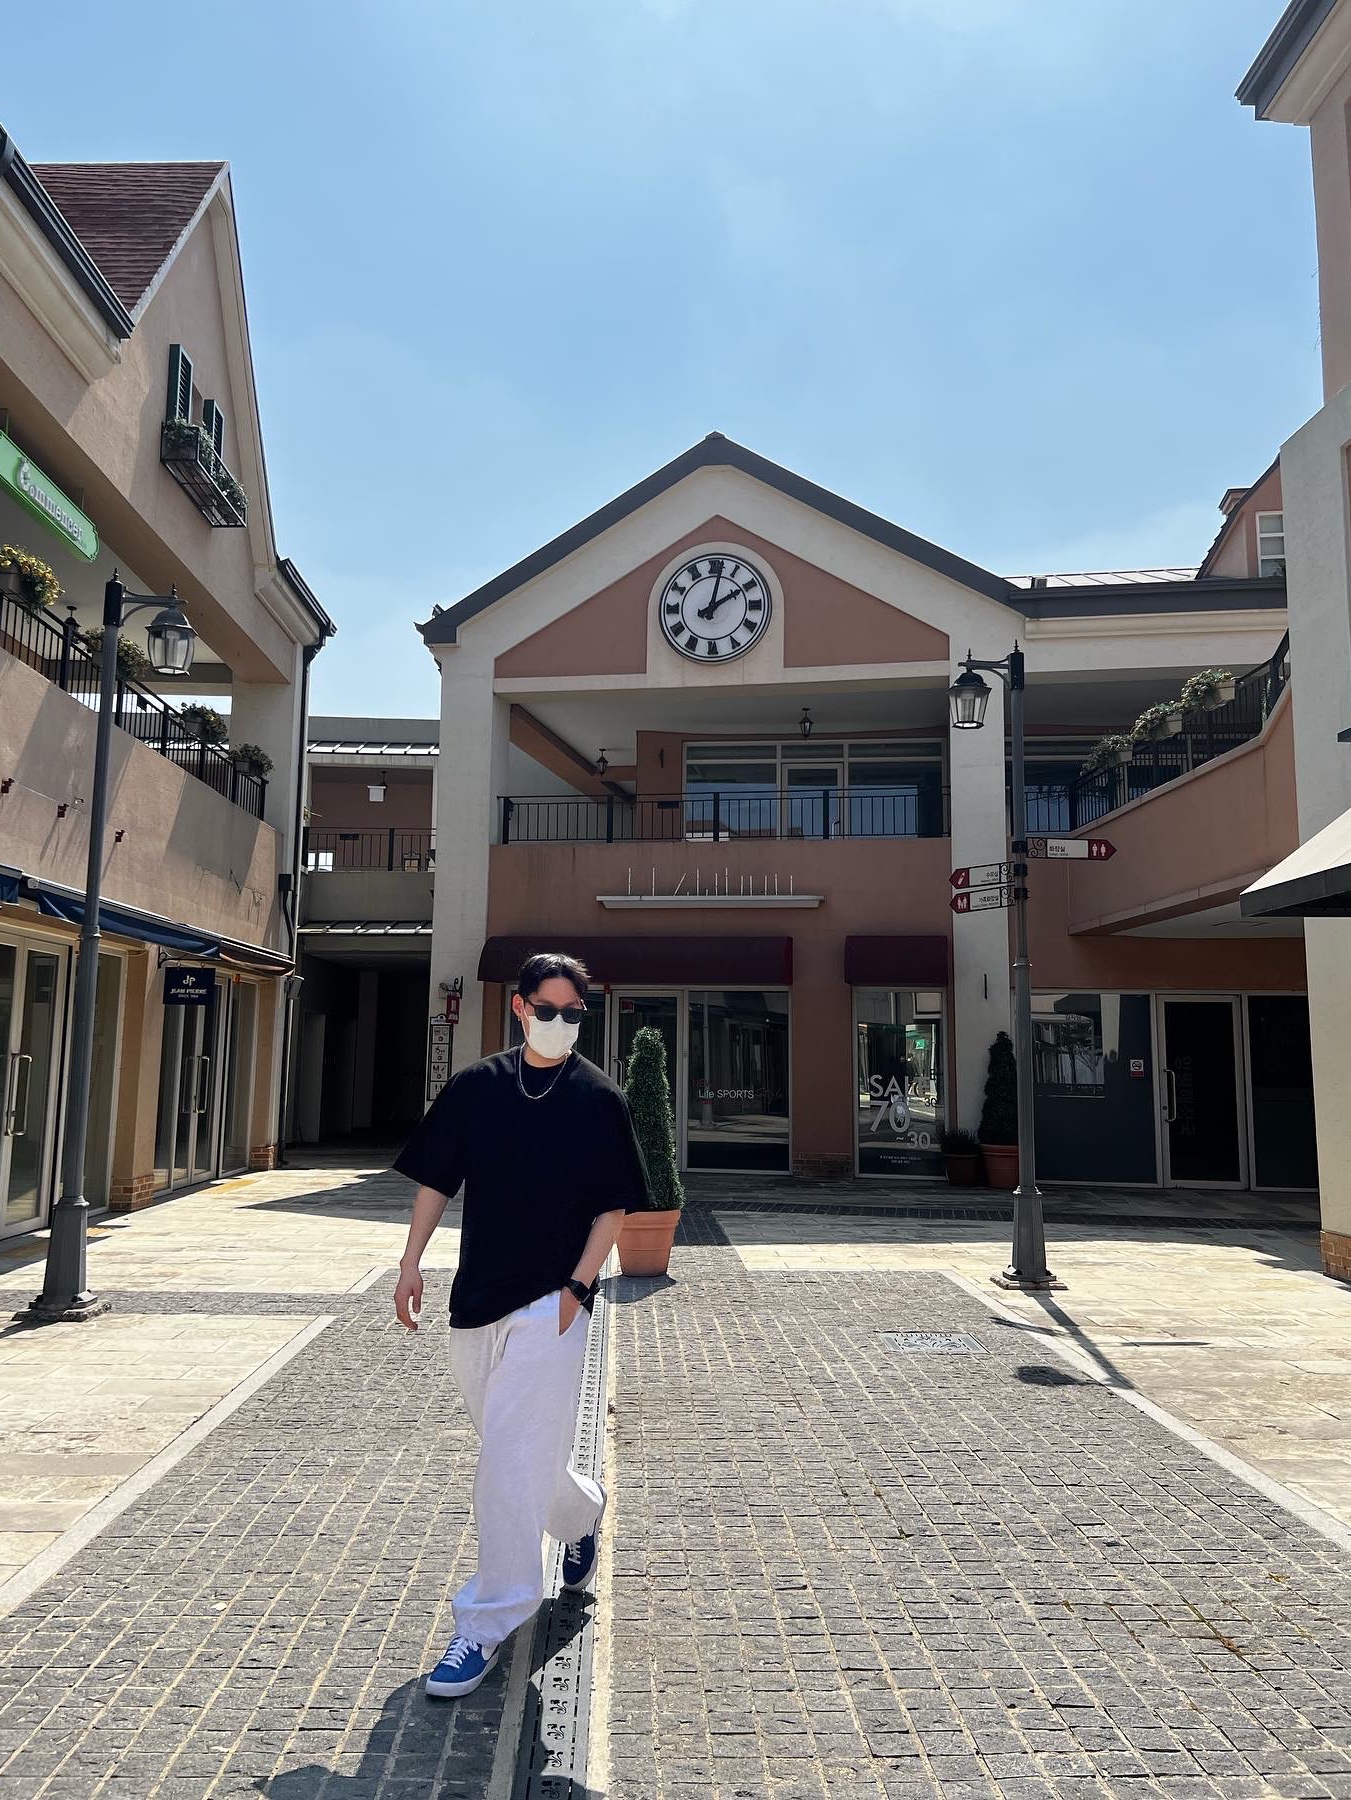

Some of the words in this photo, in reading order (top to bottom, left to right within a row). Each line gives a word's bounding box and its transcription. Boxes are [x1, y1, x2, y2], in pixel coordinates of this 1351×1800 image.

[17, 457, 84, 542] Commencer
[716, 1089, 755, 1099] SPORTS
[870, 1101, 911, 1133] 70
